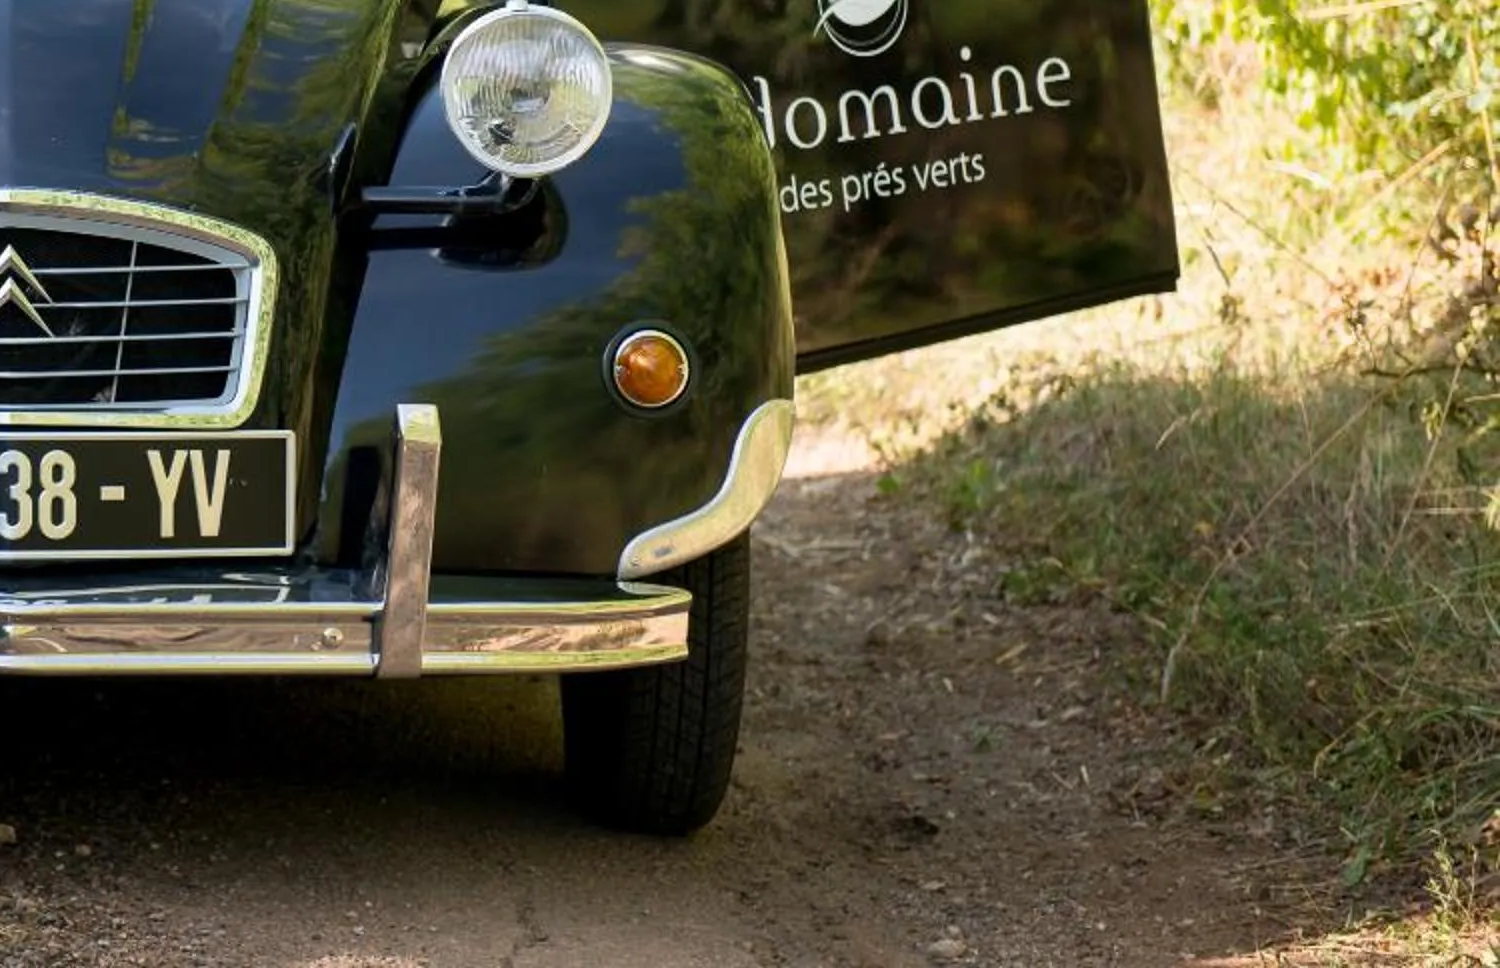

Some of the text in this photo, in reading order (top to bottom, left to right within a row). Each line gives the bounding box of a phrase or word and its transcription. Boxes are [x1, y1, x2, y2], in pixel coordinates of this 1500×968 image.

[779, 151, 986, 213] des prés verts
